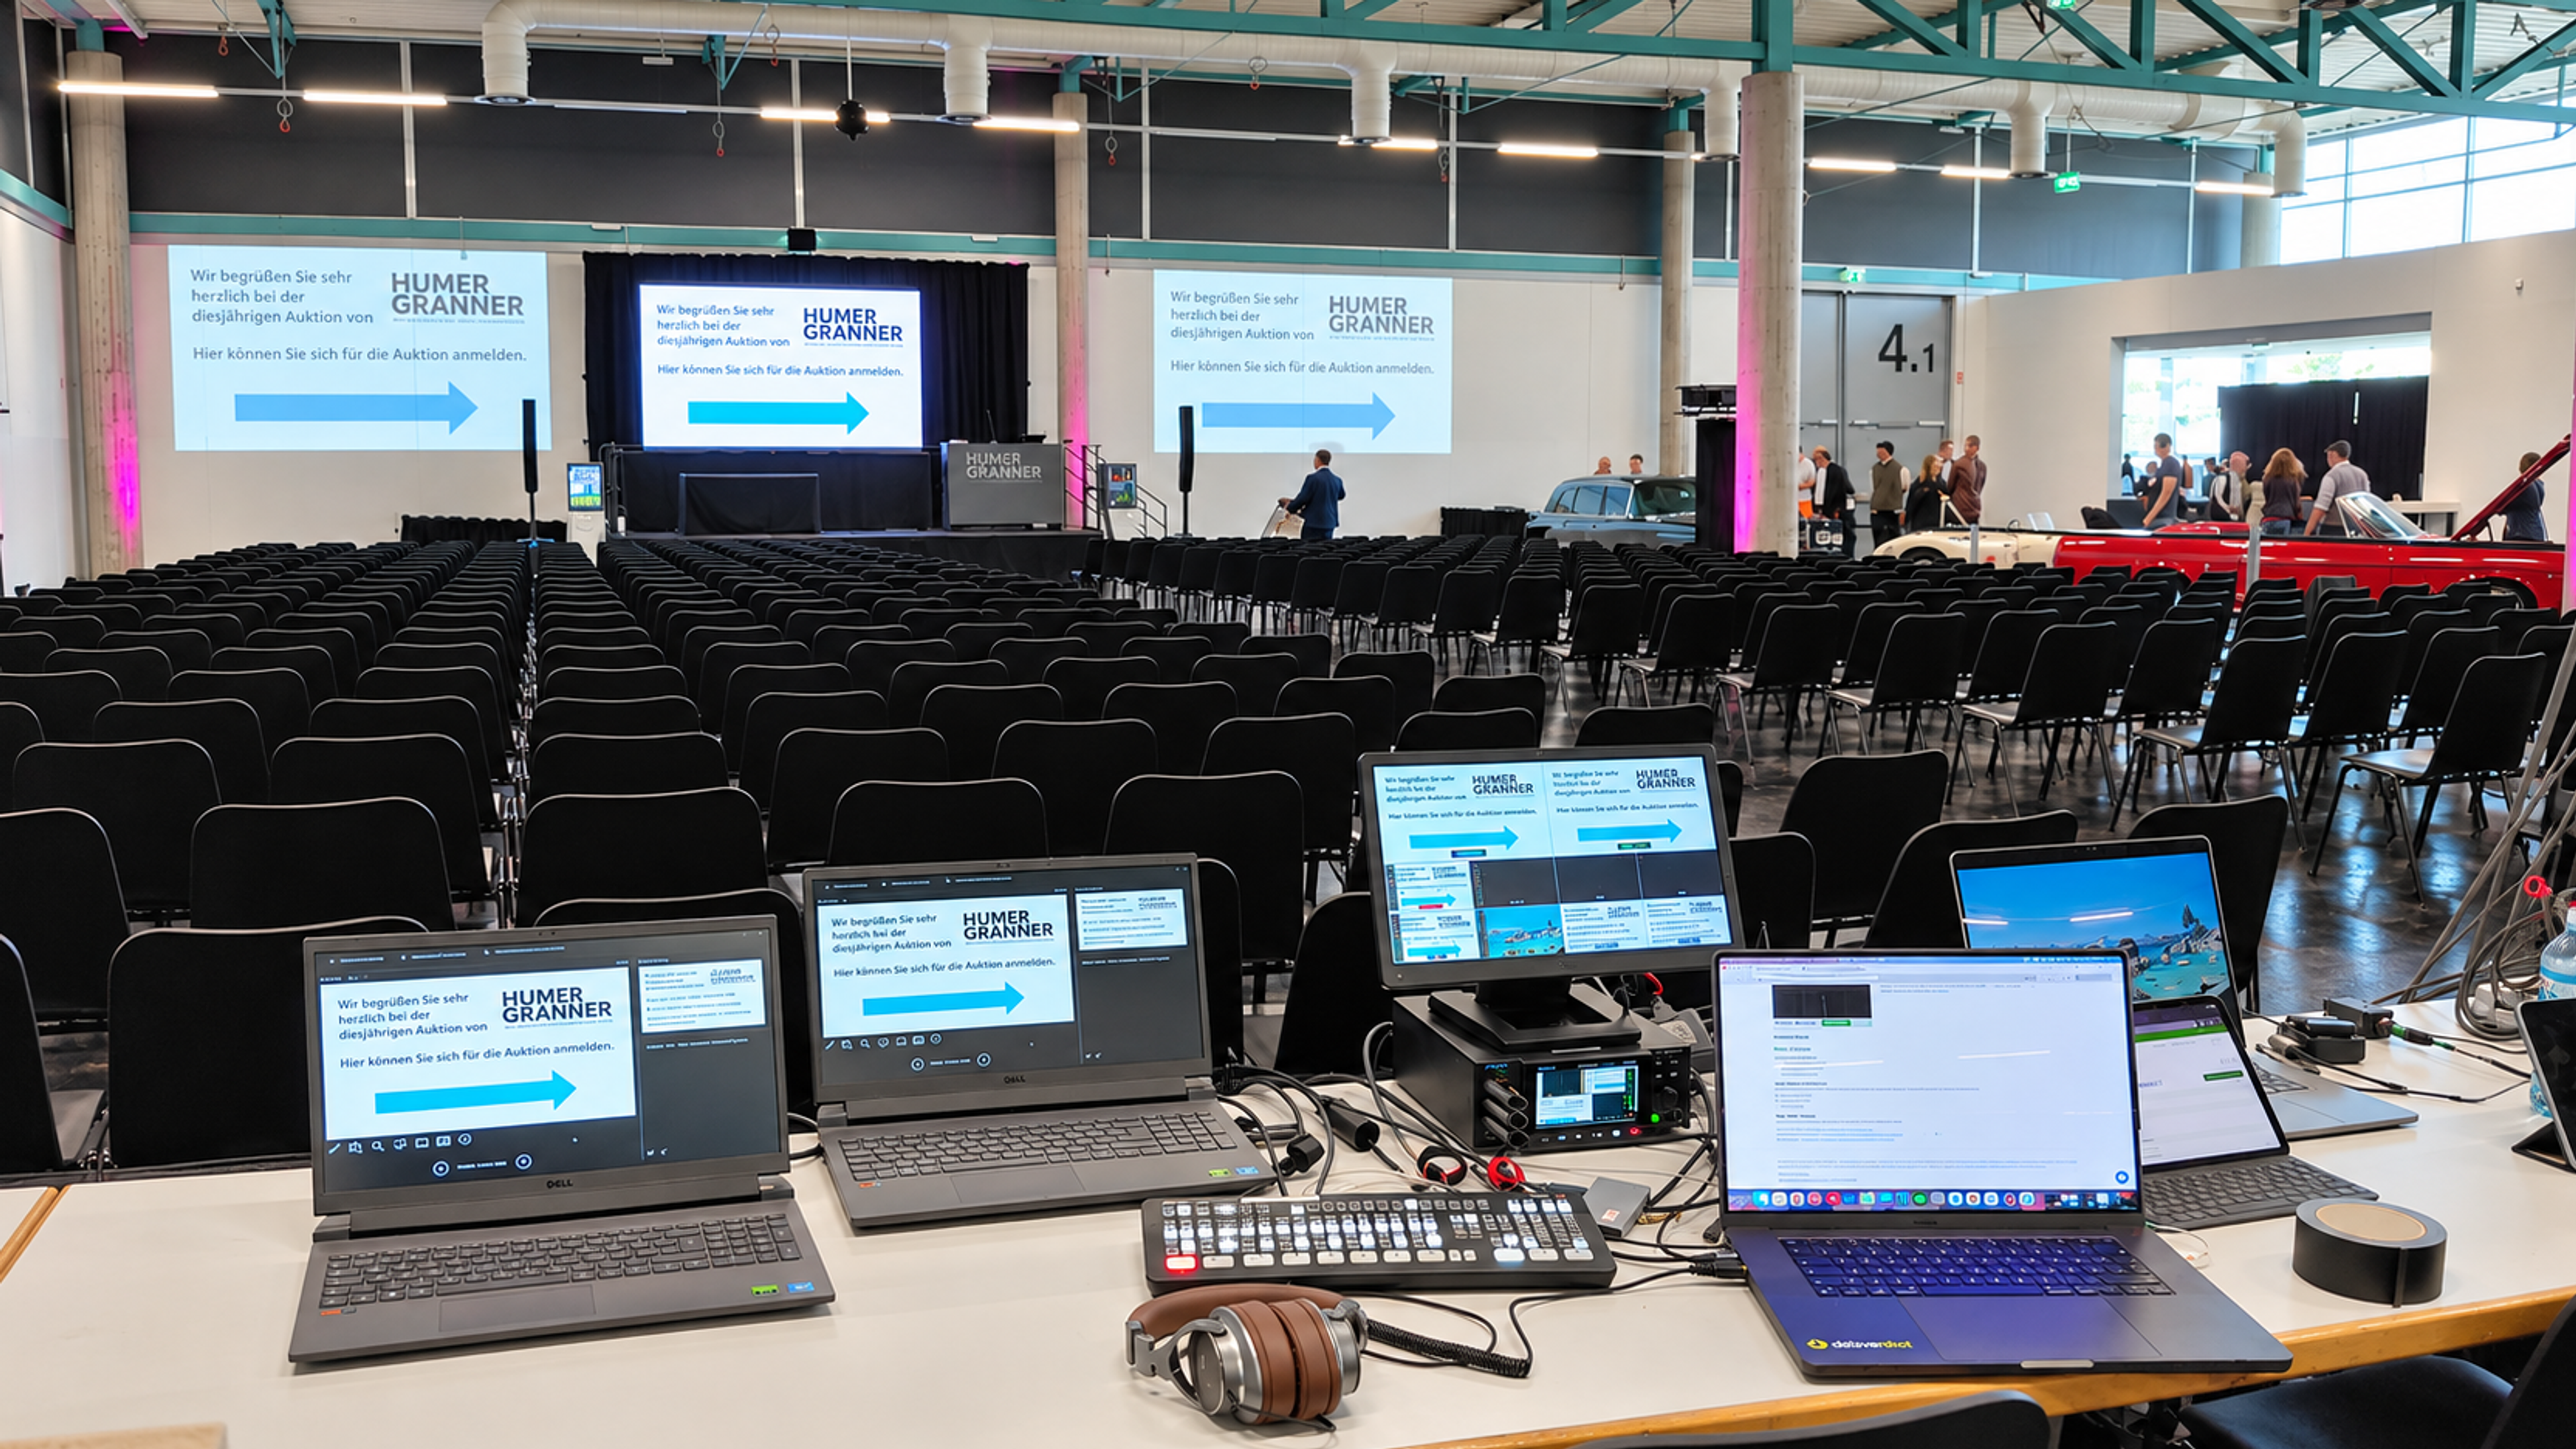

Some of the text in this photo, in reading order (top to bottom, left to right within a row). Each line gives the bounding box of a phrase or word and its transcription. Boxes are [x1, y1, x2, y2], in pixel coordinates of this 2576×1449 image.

[191, 270, 352, 286] Wir begrüßen Sie sehr
[392, 272, 490, 294] HUMER
[191, 289, 305, 303] herzlich bei der
[1170, 291, 1299, 306] Wir begrüßen Sie sehr
[392, 294, 525, 316] GRANNER
[656, 305, 775, 318] Wir begrüßen Sie sehr
[1329, 295, 1407, 315] HUMER
[192, 309, 374, 325] diesjährigen Auktion von
[804, 308, 877, 324] HUMER
[1171, 309, 1260, 322] herzlich bei der
[657, 320, 741, 331] herzlich bei der
[1329, 315, 1434, 334] GRANNER
[803, 324, 903, 341] GRANNER
[1171, 327, 1314, 341] diesjährigen Auktion von
[724, 336, 767, 346] Auktion
[1878, 323, 1934, 373] 4.1
[193, 347, 527, 362] Hier können Sie sich für die Auktion anmelden.
[657, 364, 904, 376] Hier können Sie sich für die Auktion anmelden.
[1171, 360, 1434, 374] Hier können Sie sich für die Auktion anmelden.
[966, 451, 1021, 466] HUMER
[966, 466, 1042, 479] GRANNER
[900, 915, 914, 924] Sie
[963, 910, 1030, 926] HUMER
[890, 928, 906, 937] der
[963, 922, 1054, 940] GRANNER
[933, 940, 952, 948] von
[894, 965, 908, 974] Sie
[337, 993, 469, 1010] Wir begrüßen Sie sehr
[502, 986, 584, 1007] HUMER
[339, 1010, 430, 1024] herzlich bei der
[502, 1001, 612, 1023] GRANNER
[339, 1022, 488, 1041] diesjährigen Auktion von
[340, 1041, 615, 1069] Hier können Sie sich für die Auktion anmelden.
